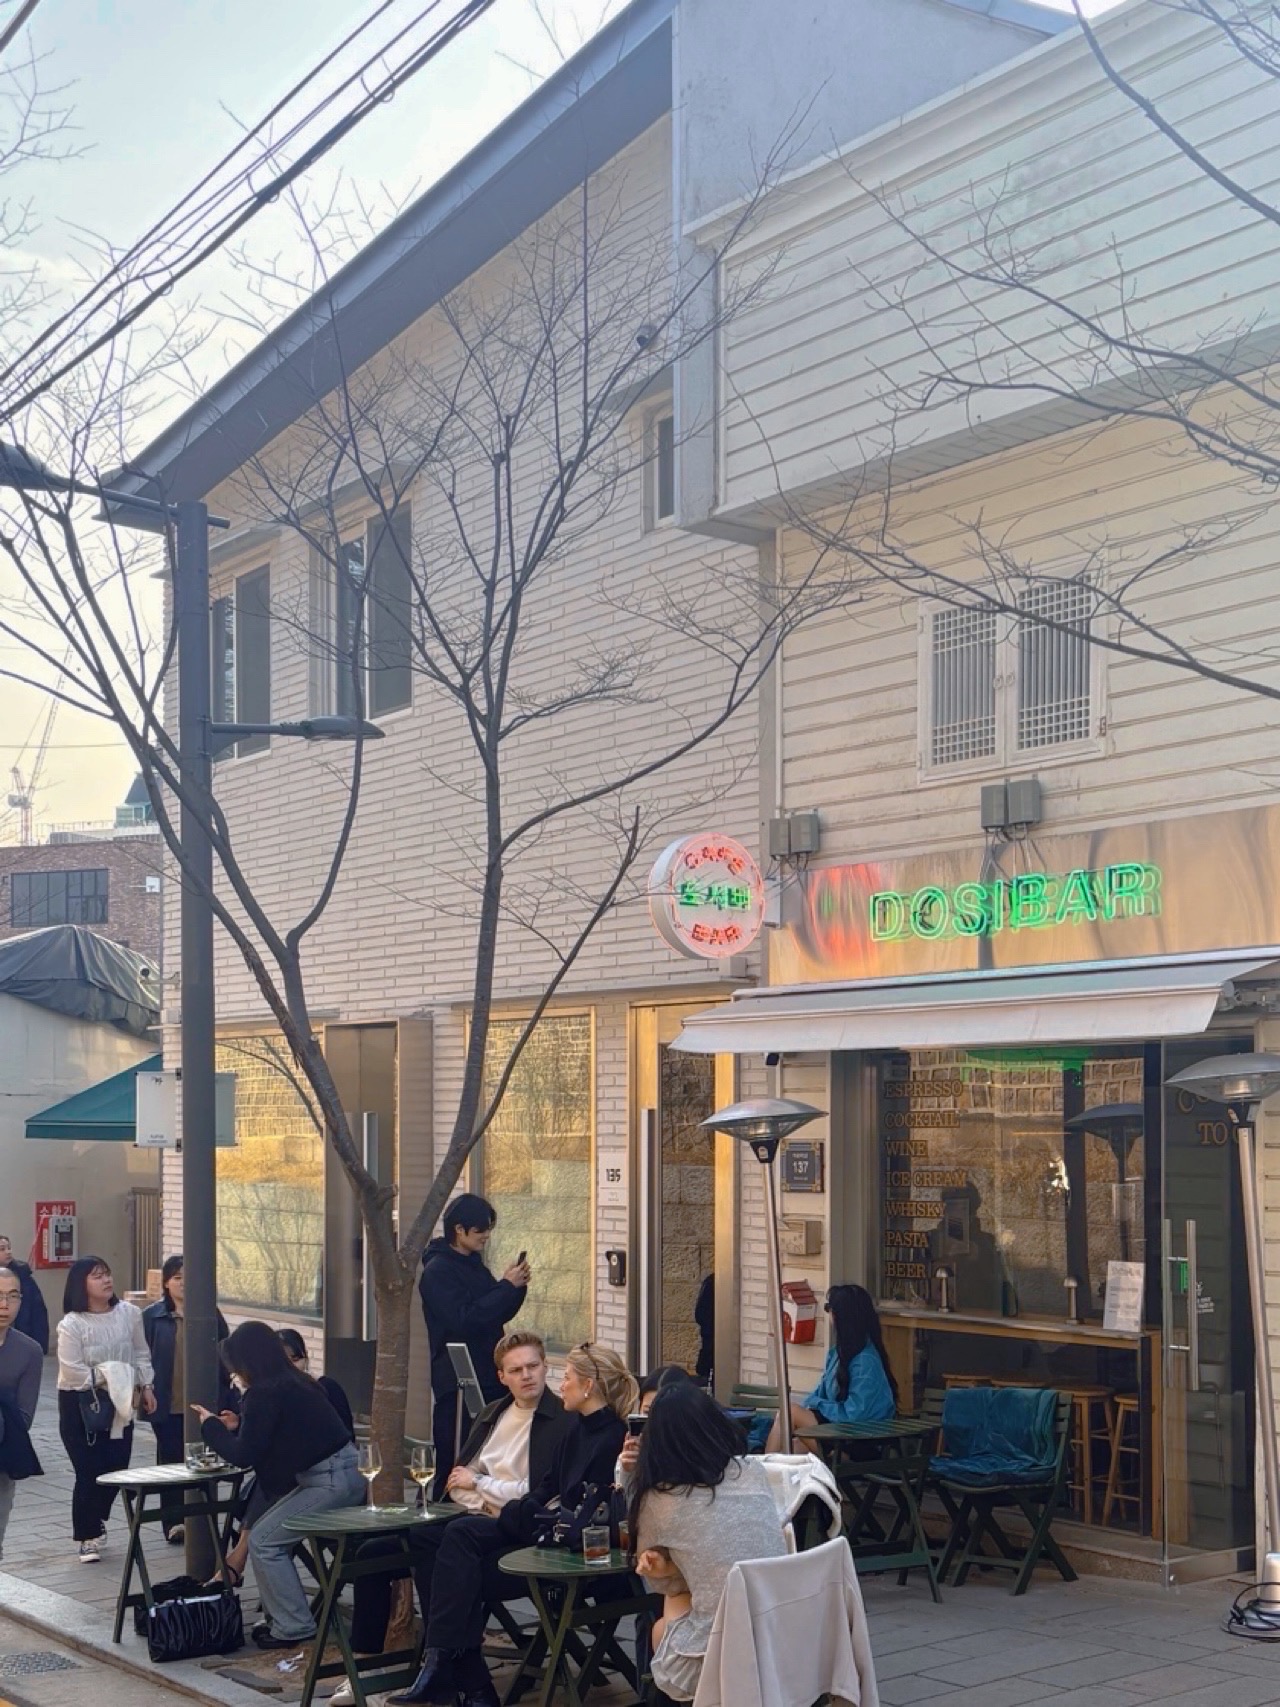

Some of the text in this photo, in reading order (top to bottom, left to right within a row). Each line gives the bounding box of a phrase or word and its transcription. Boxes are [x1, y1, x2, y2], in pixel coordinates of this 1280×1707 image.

[870, 863, 1148, 942] DOSIBAR
[690, 923, 742, 945] BAR
[885, 1080, 963, 1098] ESPRESSO
[885, 1111, 960, 1128] COCKTAIL
[885, 1140, 928, 1157] WINE
[886, 1171, 967, 1187] ICE CREAM
[886, 1201, 946, 1217] WHISKY
[886, 1231, 928, 1247] PASTA
[886, 1262, 926, 1278] BEER
